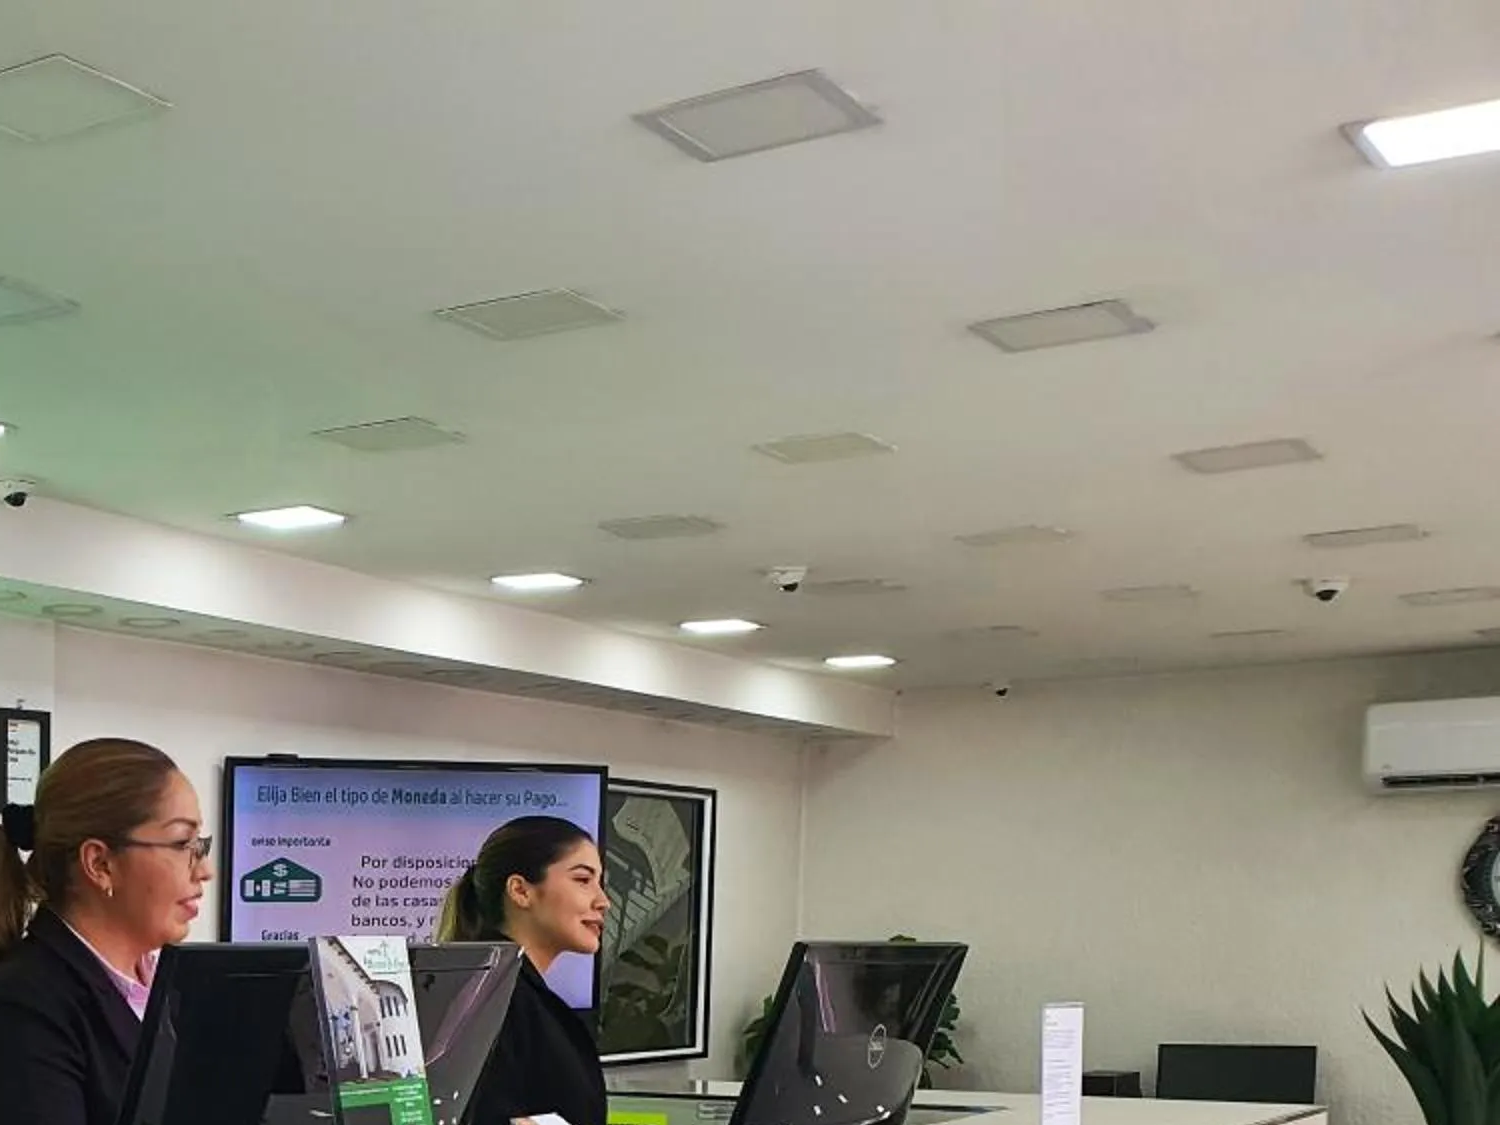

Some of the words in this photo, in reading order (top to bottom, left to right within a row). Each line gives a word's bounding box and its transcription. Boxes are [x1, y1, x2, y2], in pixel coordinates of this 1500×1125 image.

[325, 788, 337, 803] el
[341, 788, 369, 807] tipo
[372, 789, 388, 804] de
[391, 788, 447, 806] Moneda
[451, 791, 463, 806] al
[466, 792, 502, 807] hacer
[505, 793, 521, 807] su
[361, 855, 388, 869] Por
[353, 876, 375, 889] No
[379, 876, 451, 890] podemos
[351, 895, 371, 907] de
[375, 895, 399, 907] las
[351, 914, 413, 928] bancos,
[417, 918, 425, 929] y
